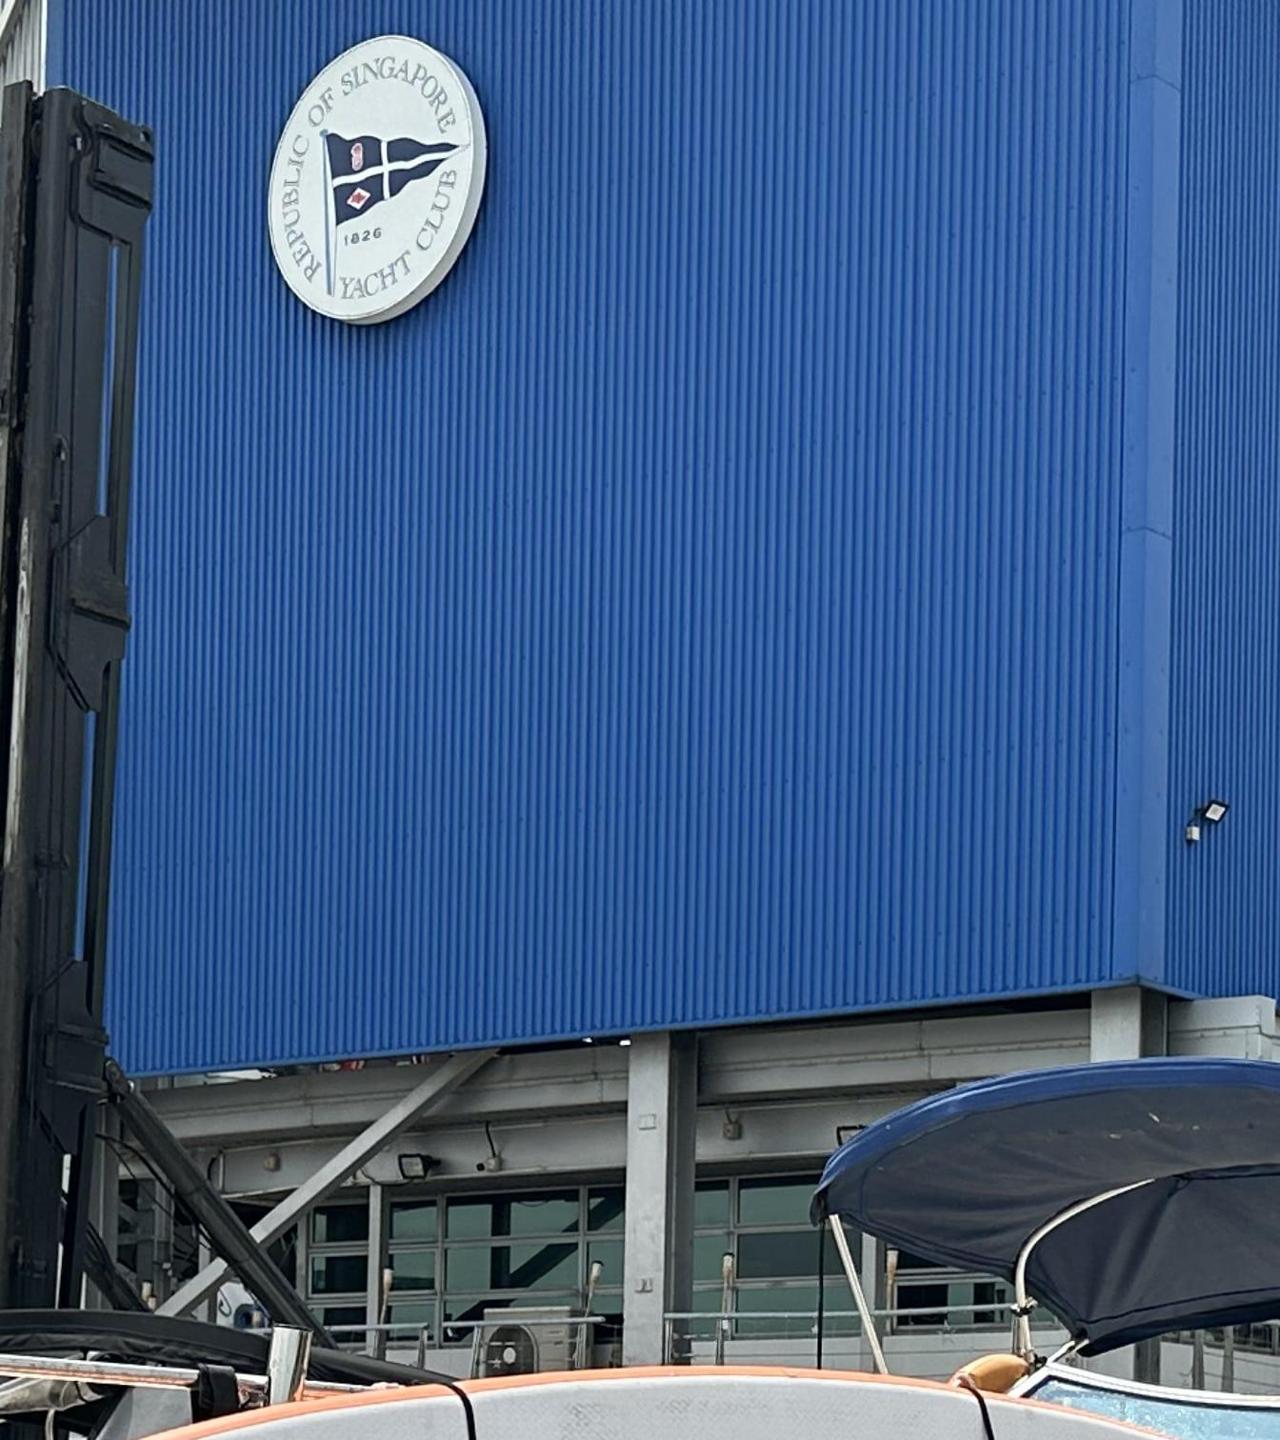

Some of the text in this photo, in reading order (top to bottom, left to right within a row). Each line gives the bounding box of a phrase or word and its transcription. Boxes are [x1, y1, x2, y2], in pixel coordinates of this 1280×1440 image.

[282, 55, 457, 282] REPUBLIC OF SINGAPORE
[339, 168, 458, 299] YACHT CLUB
[344, 227, 383, 247] 1826
